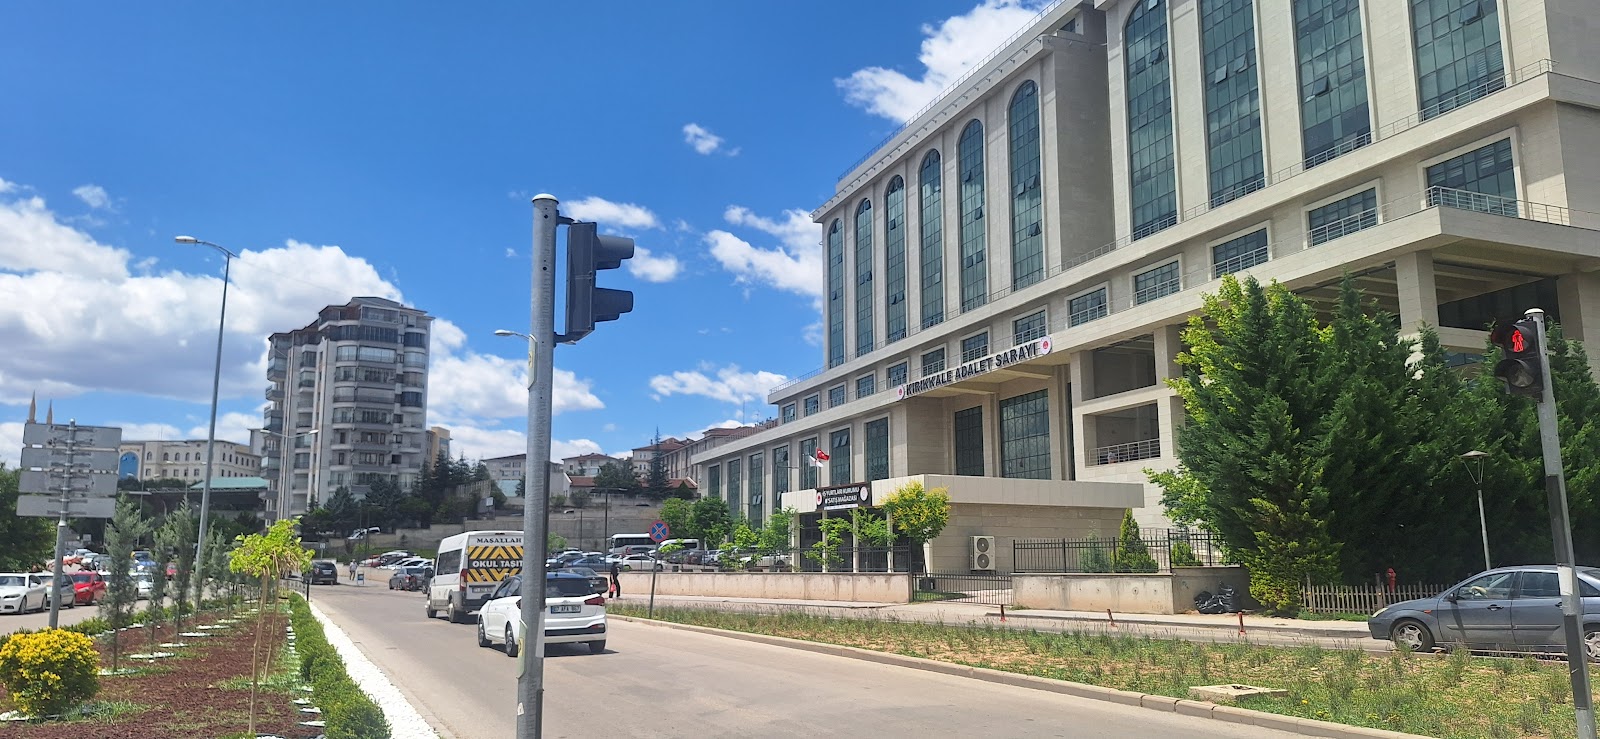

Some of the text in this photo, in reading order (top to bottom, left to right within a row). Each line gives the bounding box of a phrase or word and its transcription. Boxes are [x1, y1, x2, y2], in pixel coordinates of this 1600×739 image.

[906, 342, 1037, 396] KIRIKKALE ADALET SARAYI
